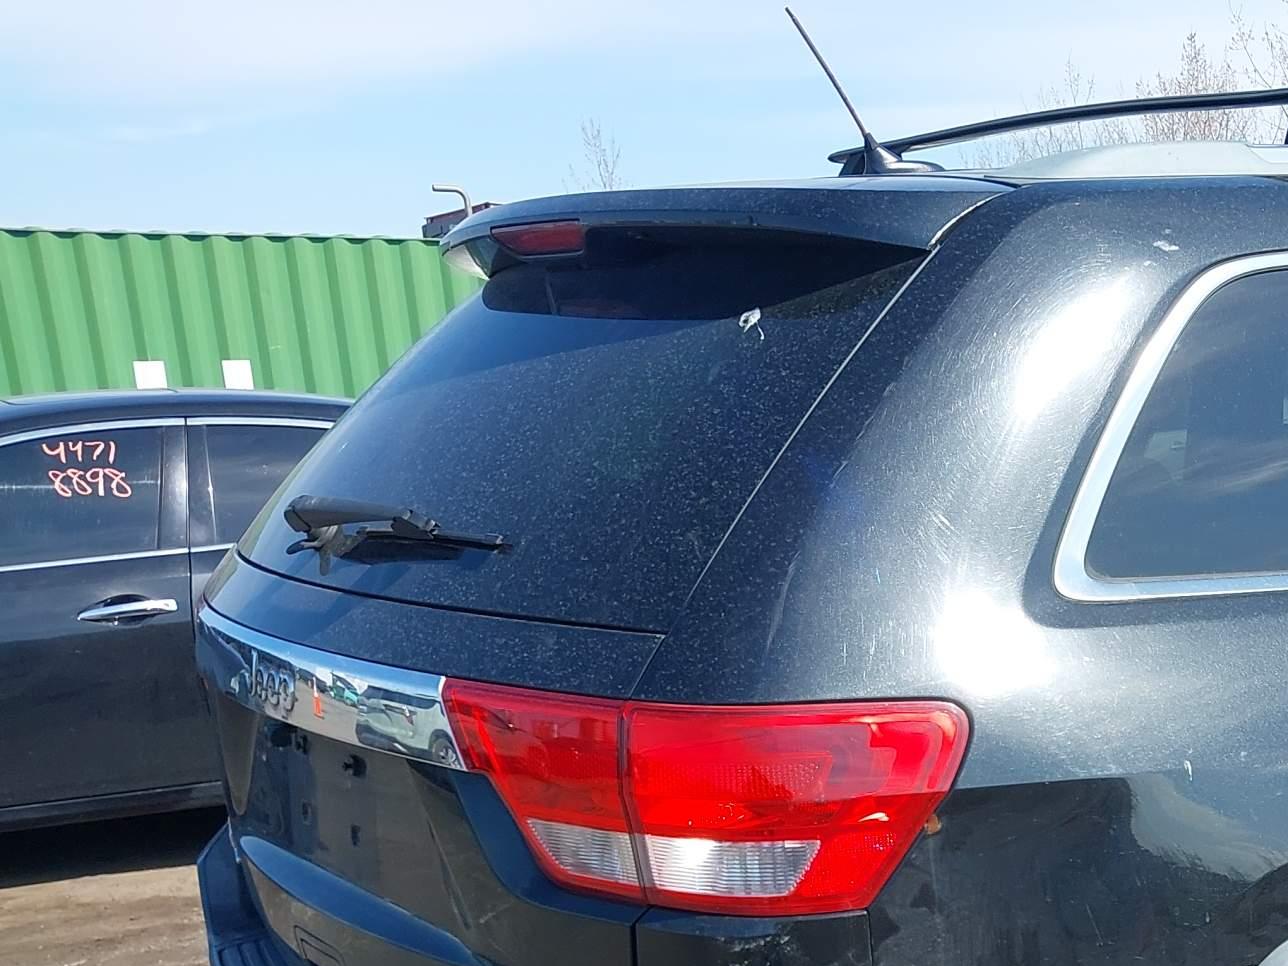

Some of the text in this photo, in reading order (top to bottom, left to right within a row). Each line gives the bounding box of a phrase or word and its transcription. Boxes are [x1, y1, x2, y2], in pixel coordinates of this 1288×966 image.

[42, 440, 116, 464] 4471
[48, 468, 132, 497] 8898
[250, 648, 296, 712] Jeep
